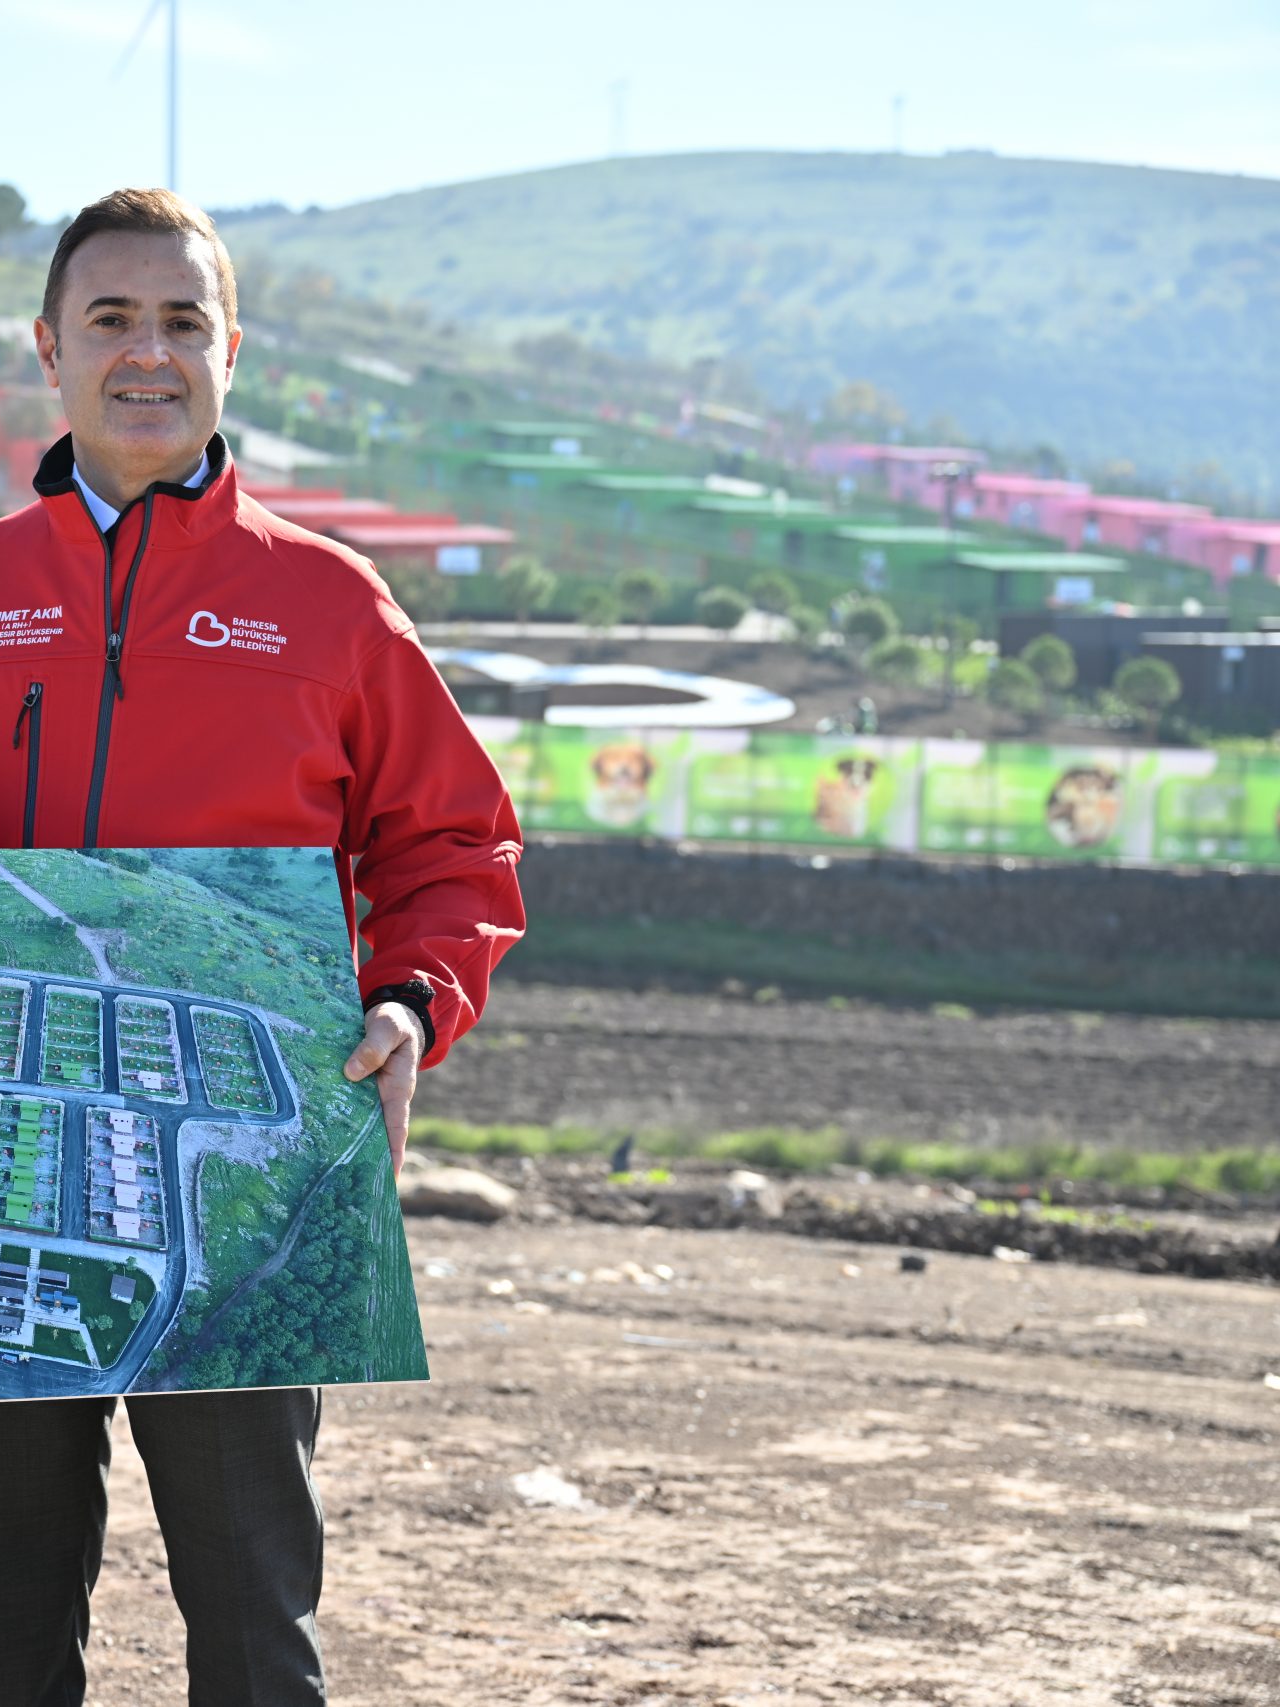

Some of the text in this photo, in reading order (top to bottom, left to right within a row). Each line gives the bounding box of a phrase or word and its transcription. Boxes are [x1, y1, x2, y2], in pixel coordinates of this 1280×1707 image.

[31, 605, 63, 620] AKIN
[232, 617, 278, 633] BALIKESİR
[231, 627, 287, 645] BÜYÜKŞEHİR
[230, 638, 280, 655] BELEDİYESİ
